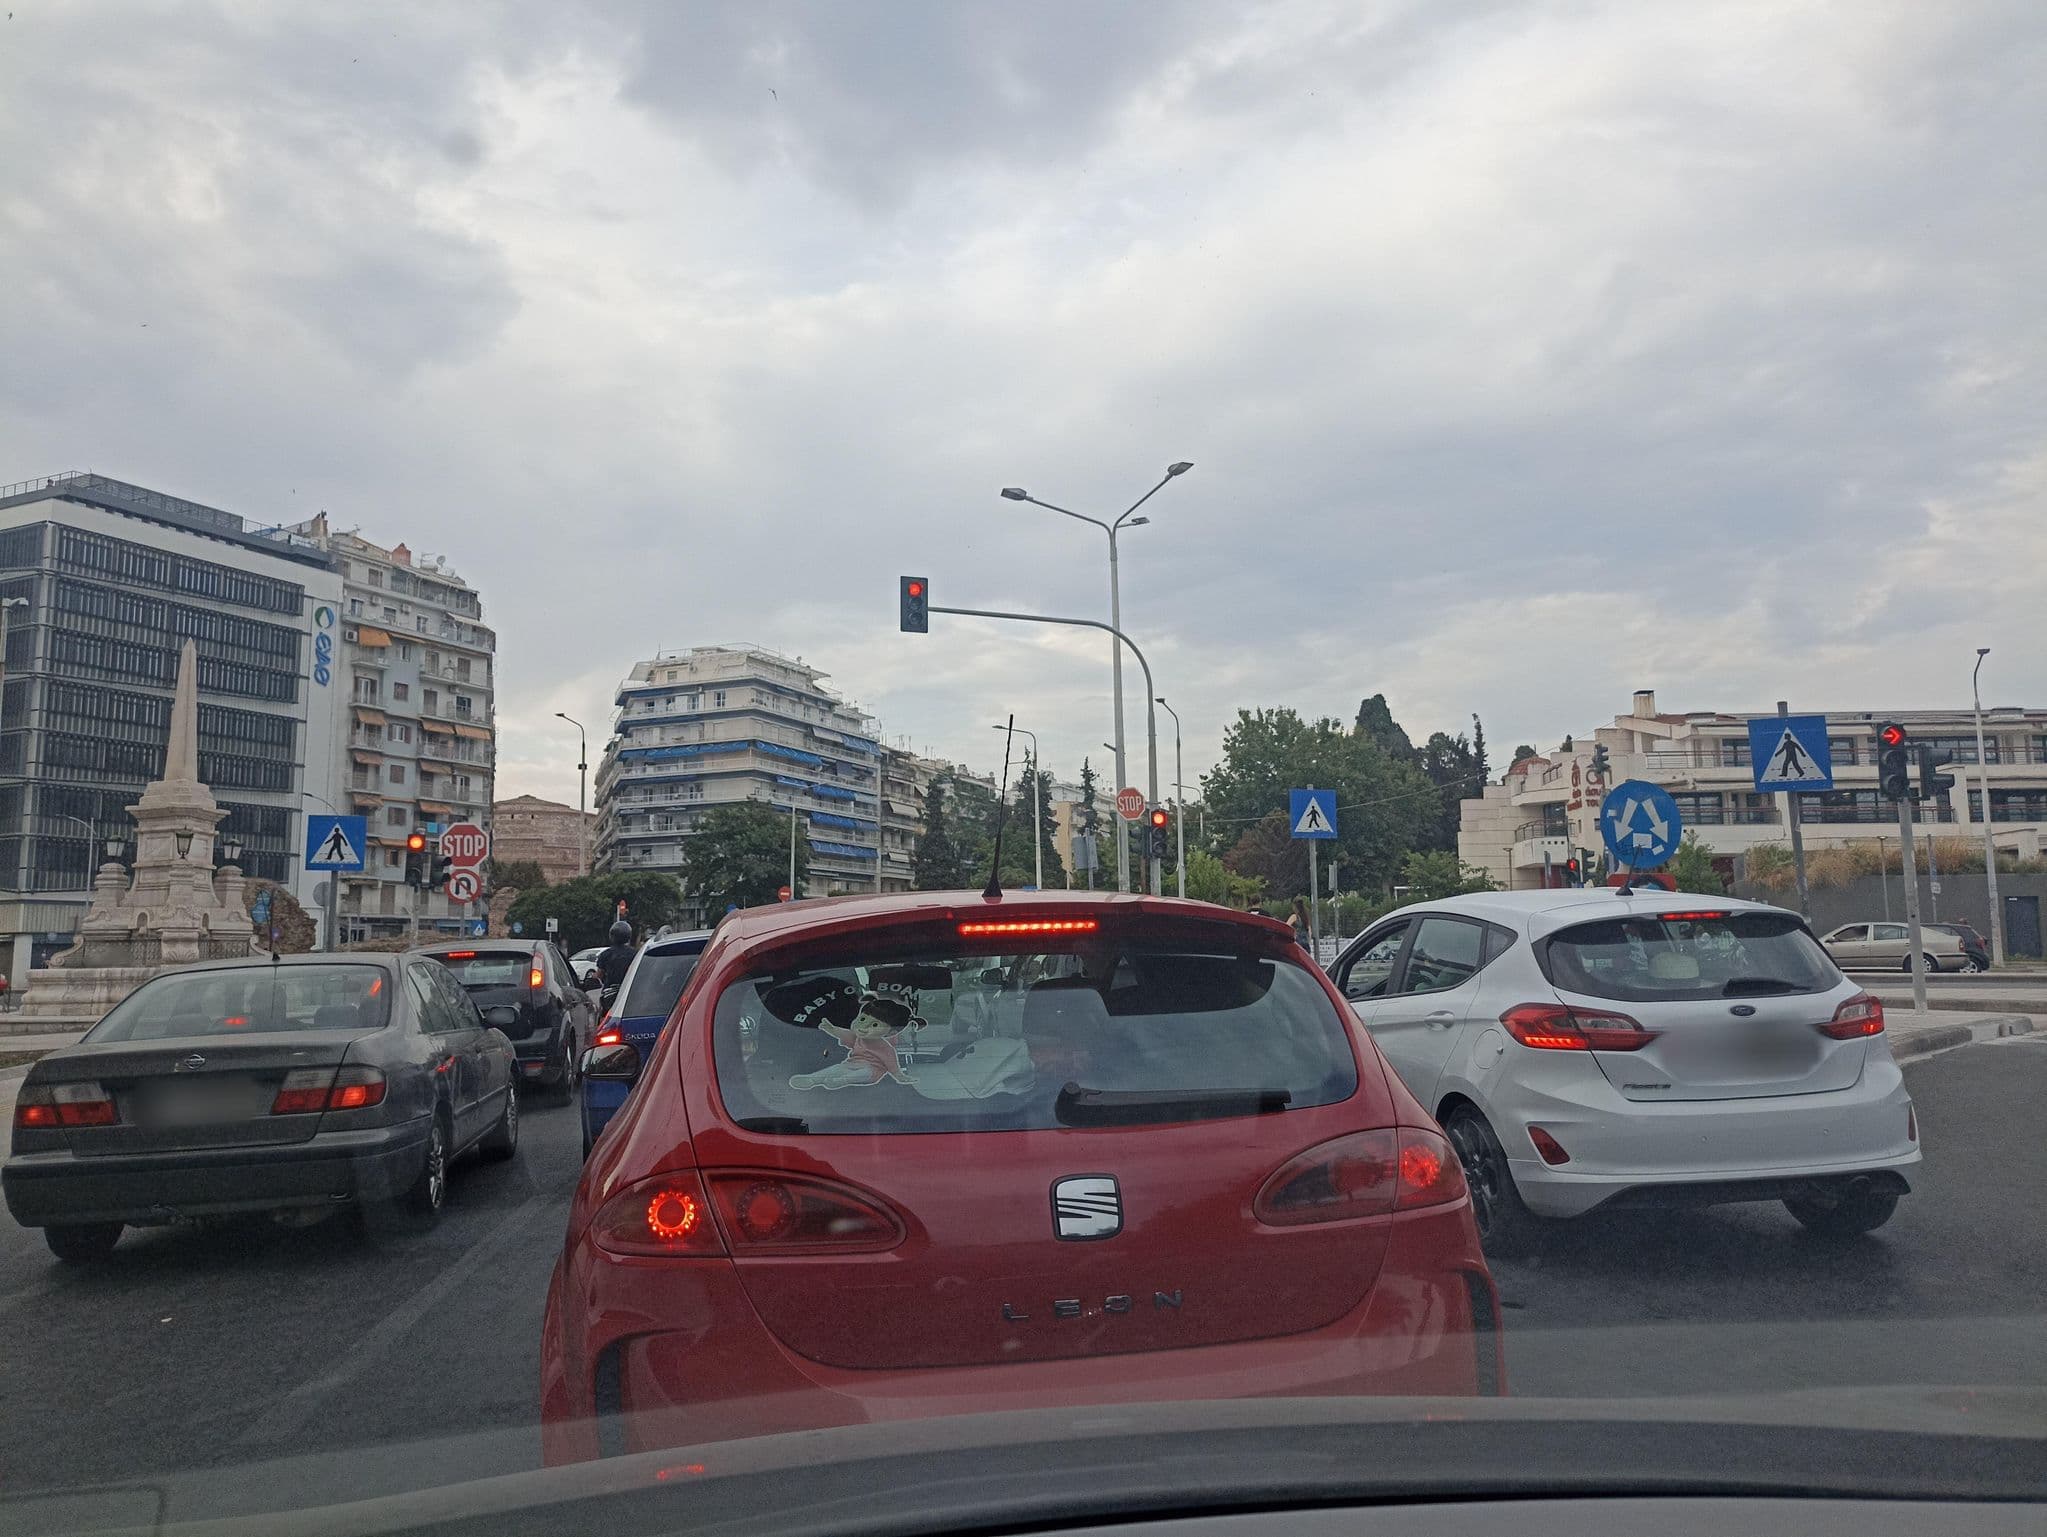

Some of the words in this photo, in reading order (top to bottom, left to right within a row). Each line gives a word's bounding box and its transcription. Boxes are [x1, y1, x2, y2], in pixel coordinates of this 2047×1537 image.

[1118, 796, 1142, 811] STOP
[444, 835, 485, 857] STOP
[794, 991, 837, 1023] BABY
[1003, 1289, 1182, 1322] LEON
